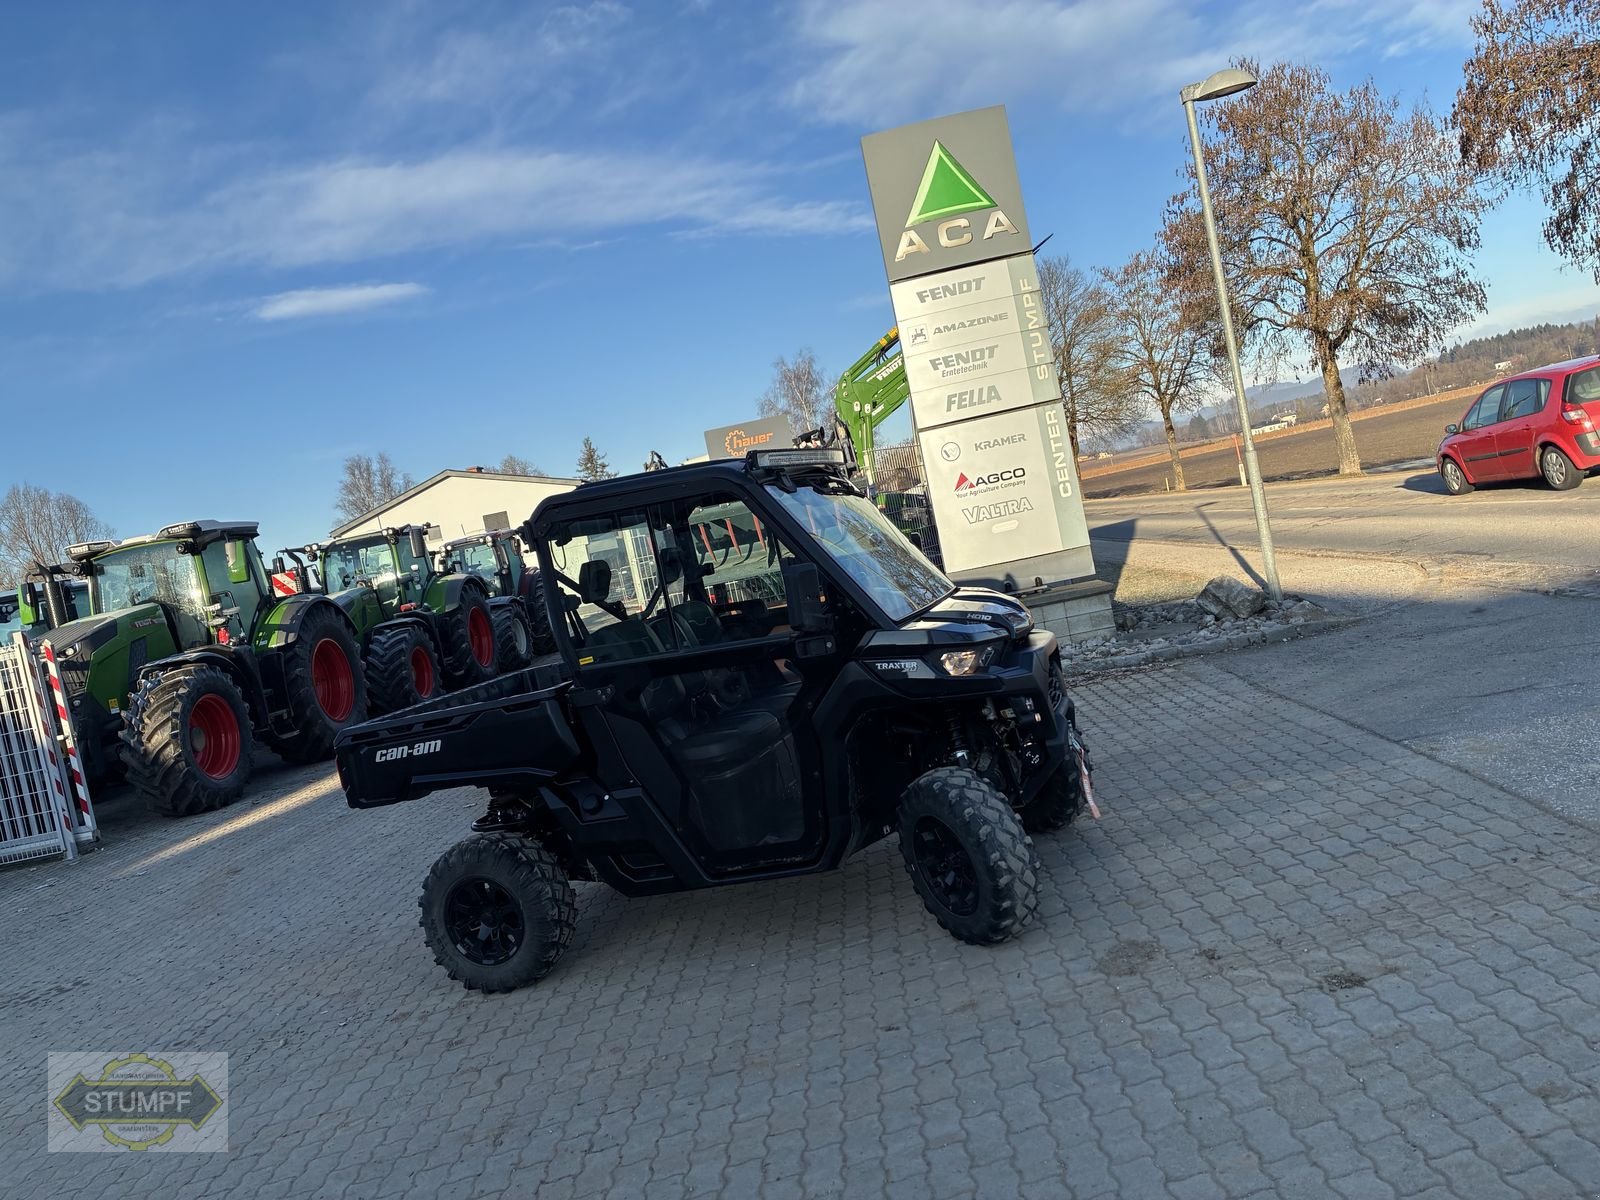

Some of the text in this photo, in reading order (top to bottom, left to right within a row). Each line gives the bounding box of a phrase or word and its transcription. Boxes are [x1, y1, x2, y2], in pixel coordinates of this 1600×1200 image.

[894, 210, 1019, 262] ACA
[916, 276, 986, 303] FENDT
[933, 312, 1009, 335] AMAZONE
[928, 344, 999, 371] FENDT
[941, 360, 989, 378] Erntetechnik
[946, 385, 1002, 412] FELLA
[1019, 278, 1073, 498] CENTER STUMPF
[733, 432, 773, 448] hauer
[974, 433, 1027, 452] KRAMER
[975, 467, 1026, 487] AGCO
[956, 479, 1026, 499] Your Agriculture Company
[961, 496, 1034, 525] VALTRA
[875, 661, 918, 670] TRAXTER
[375, 739, 442, 763] can-am
